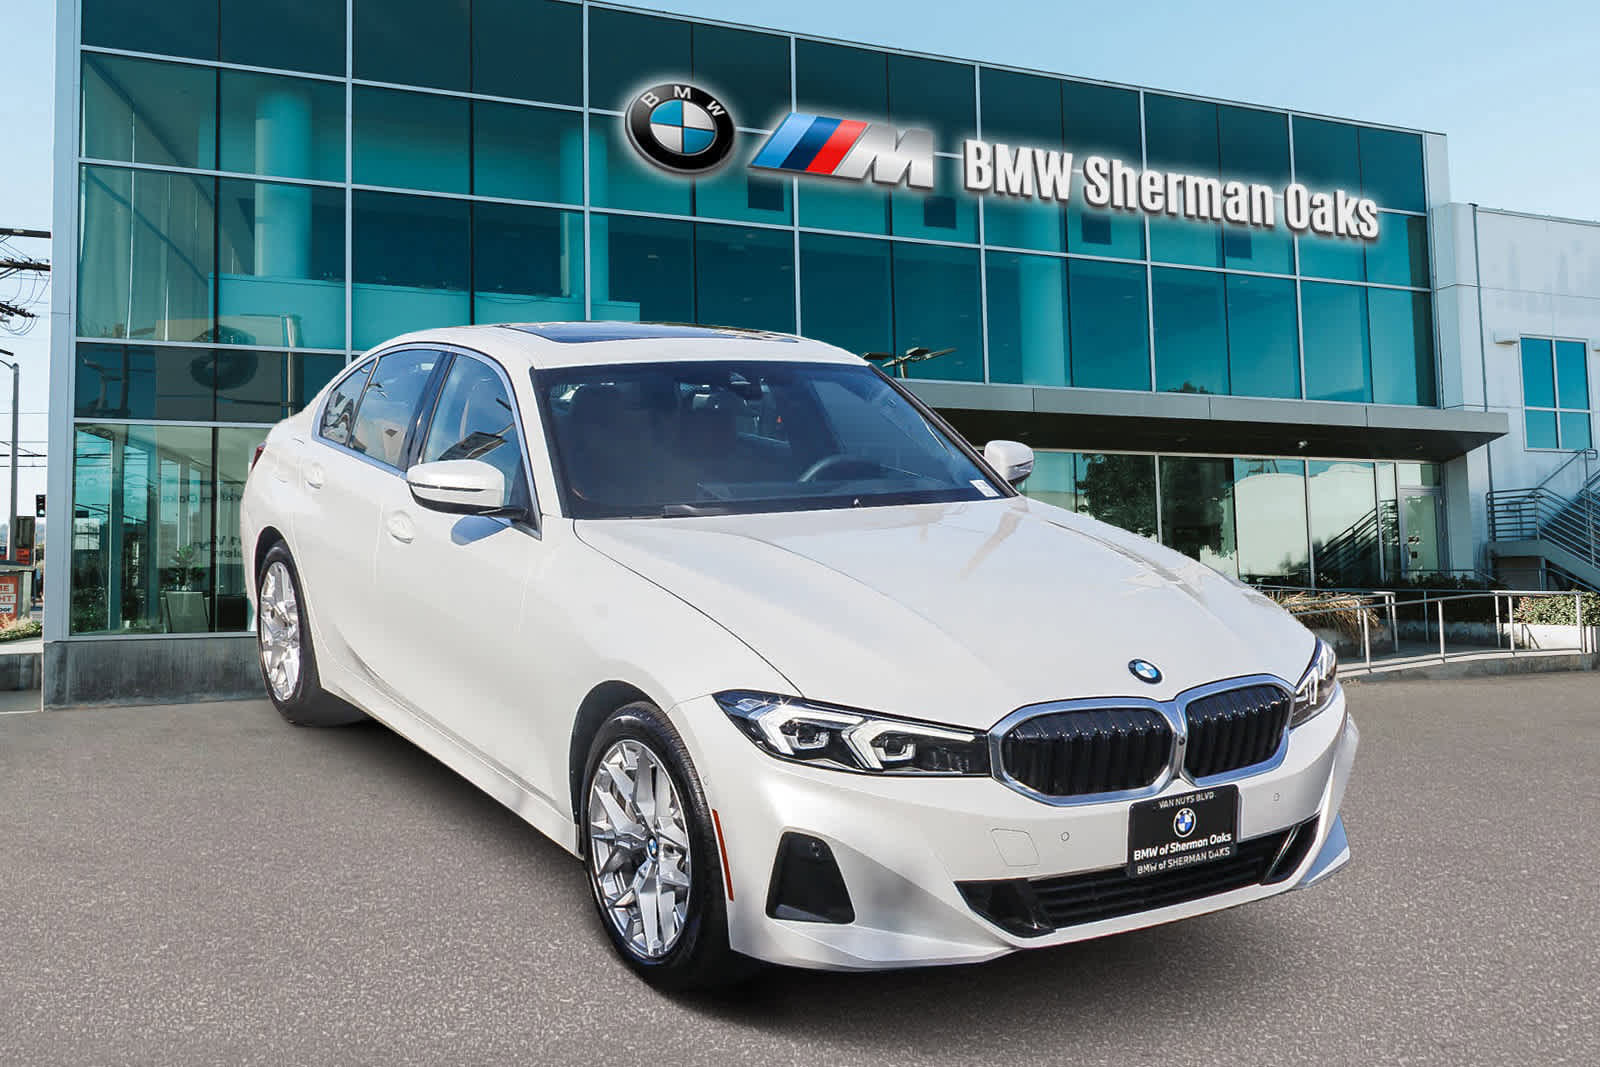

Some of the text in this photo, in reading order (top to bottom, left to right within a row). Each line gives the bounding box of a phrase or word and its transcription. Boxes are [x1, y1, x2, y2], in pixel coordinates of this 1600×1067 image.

[640, 85, 726, 117] BMW
[964, 139, 1380, 240] BMW Sherman Oaks
[1159, 799, 1174, 808] VAN
[1134, 832, 1232, 861] BMW of Sherman Oaks
[1137, 847, 1230, 875] BMW of SHERMAN OAKS
